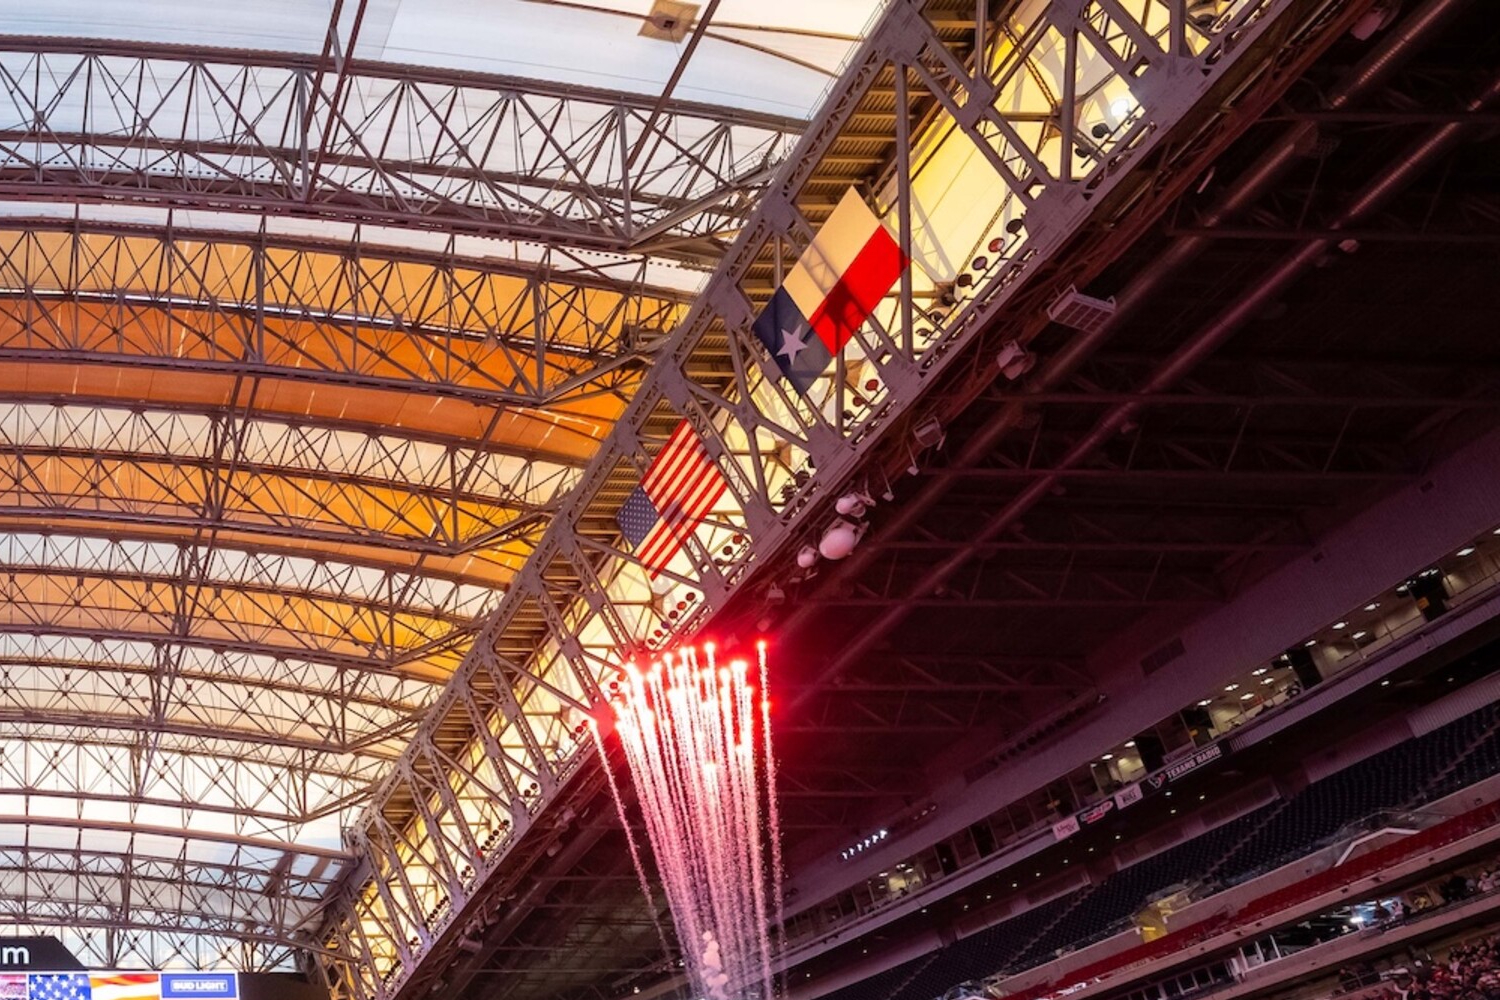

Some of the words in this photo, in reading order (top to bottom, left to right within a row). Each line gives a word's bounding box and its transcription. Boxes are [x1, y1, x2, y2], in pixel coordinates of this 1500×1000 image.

[1165, 758, 1197, 779] TEXANS
[1197, 746, 1222, 766] RADIO
[172, 981, 194, 991] BUD
[197, 981, 227, 991] LIGHT
